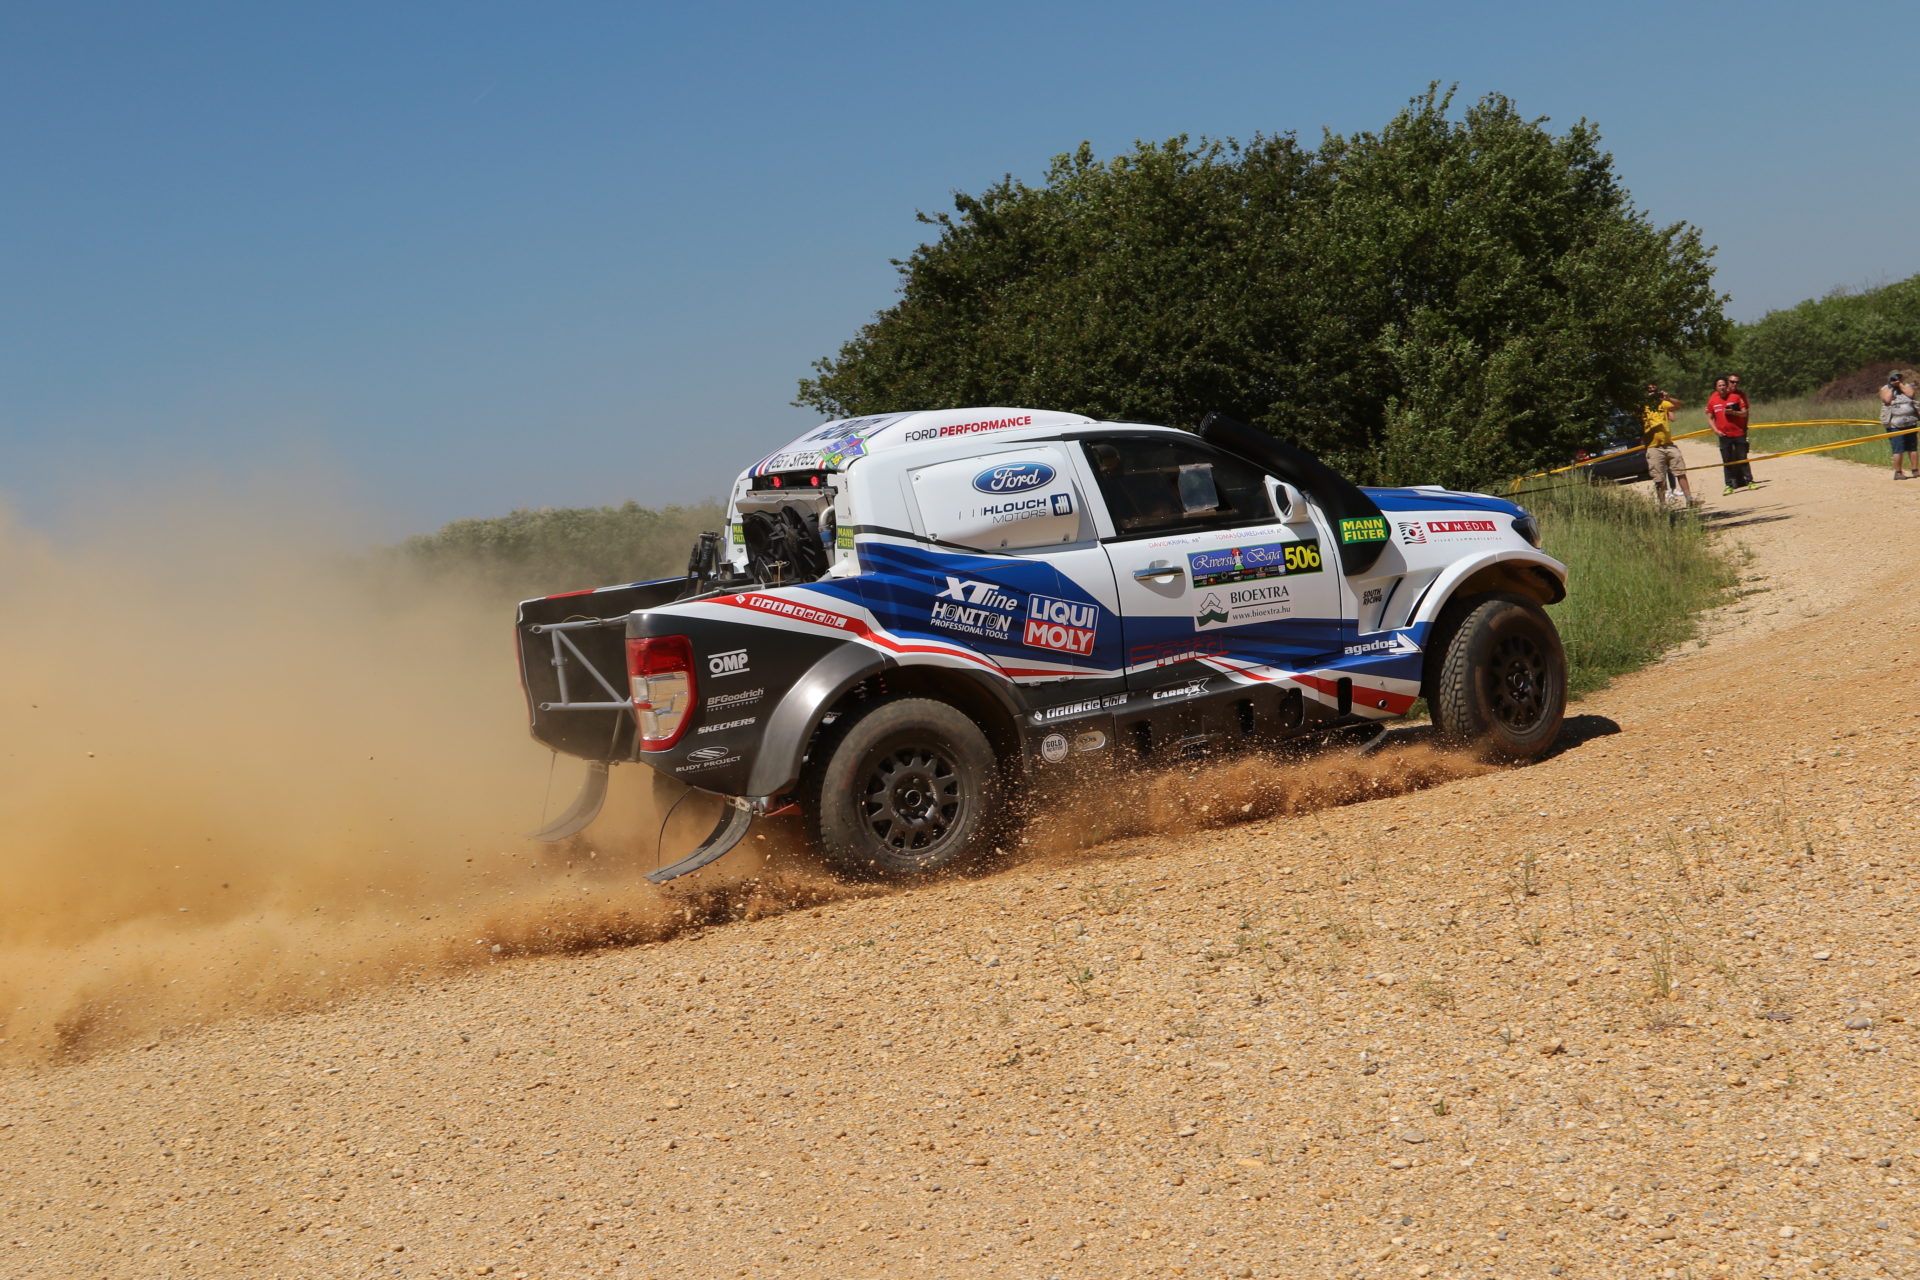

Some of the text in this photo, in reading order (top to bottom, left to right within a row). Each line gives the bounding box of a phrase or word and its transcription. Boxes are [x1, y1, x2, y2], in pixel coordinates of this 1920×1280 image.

[905, 428, 938, 442] FORD
[939, 415, 1031, 437] PERFORMANCE
[990, 465, 1041, 491] Ford
[983, 498, 1047, 516] HLOUCH
[992, 509, 1047, 524] MOTORS
[1342, 518, 1383, 530] MANN
[1344, 528, 1386, 542] FILTER
[1246, 547, 1282, 566] Baja
[1284, 544, 1320, 570] 506
[935, 576, 1018, 611] XTline
[1230, 585, 1289, 604] BIOEXTRA
[1363, 588, 1382, 599] SOUTH
[931, 601, 1012, 632] HONITON
[1030, 597, 1095, 628] LIQUI
[1232, 606, 1291, 620] www.bioextra.hu
[930, 618, 1009, 640] PROFESSIONAL TOOLS
[1027, 622, 1094, 651] MOLY
[1344, 634, 1398, 656] agados
[709, 653, 749, 674] OMP
[707, 687, 763, 706] BFGoodrich
[697, 716, 757, 735] SKECHERS
[1046, 738, 1063, 748] GOLD
[675, 763, 702, 772] RUDY
[703, 755, 742, 768] PROJECT
